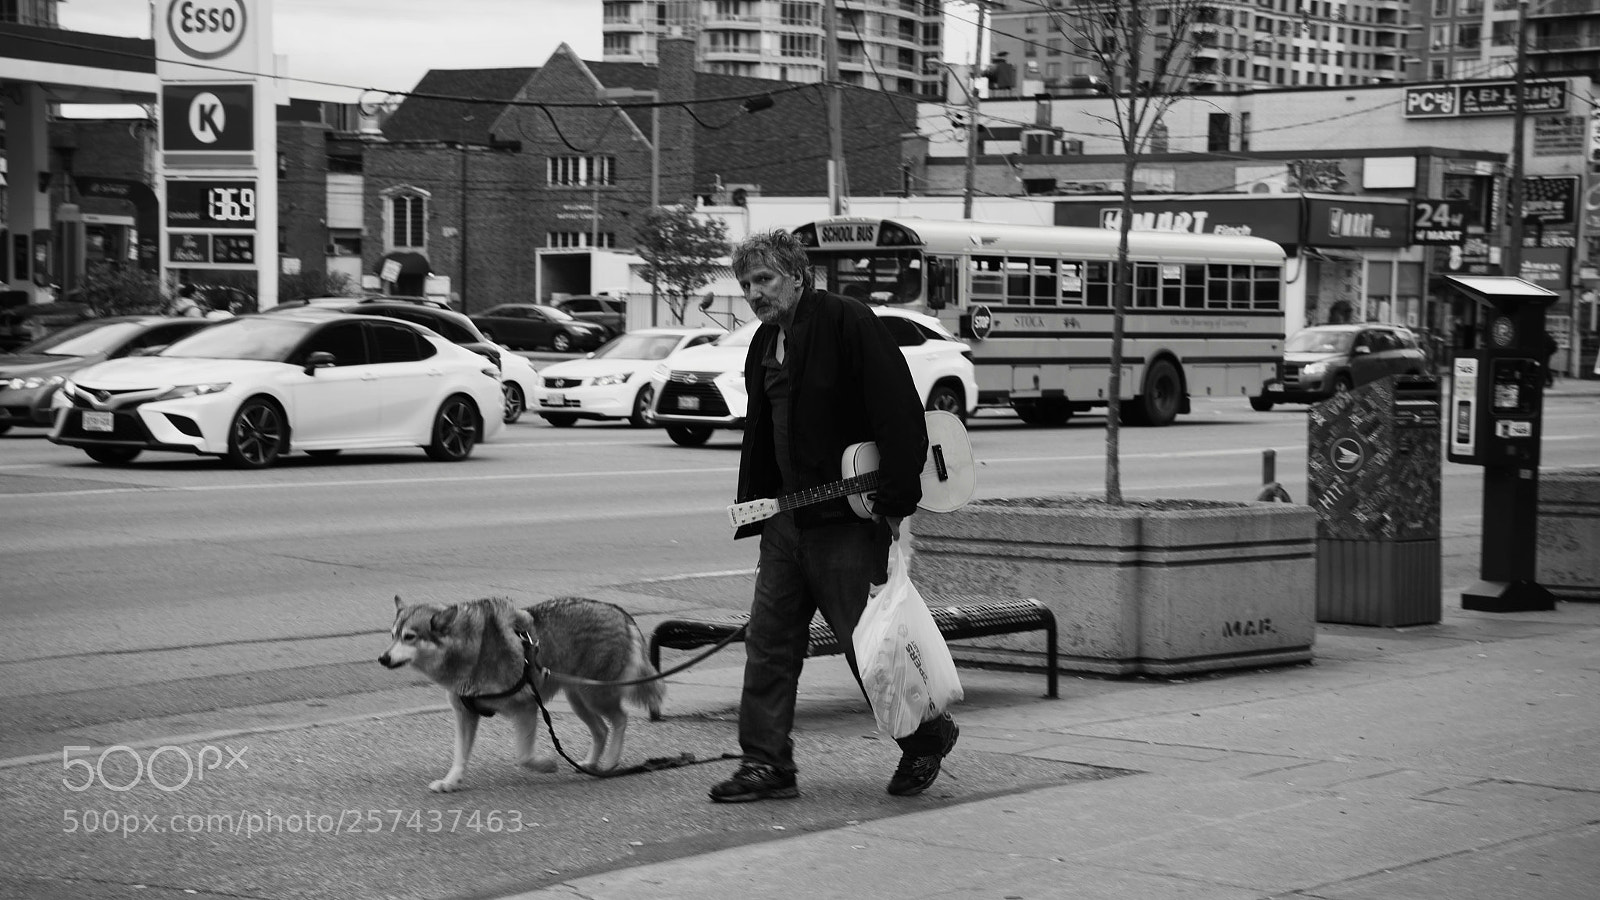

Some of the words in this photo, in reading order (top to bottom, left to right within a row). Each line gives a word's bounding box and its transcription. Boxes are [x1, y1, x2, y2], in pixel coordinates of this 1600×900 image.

[181, 1, 235, 33] Esso
[1408, 92, 1453, 113] PC방
[199, 103, 223, 141] K
[1131, 211, 1208, 234] MART
[822, 226, 854, 242] SCHOOL
[857, 226, 874, 242] BUS
[1427, 230, 1462, 240] MART
[974, 315, 990, 329] STOP
[1014, 315, 1046, 329] STOCK
